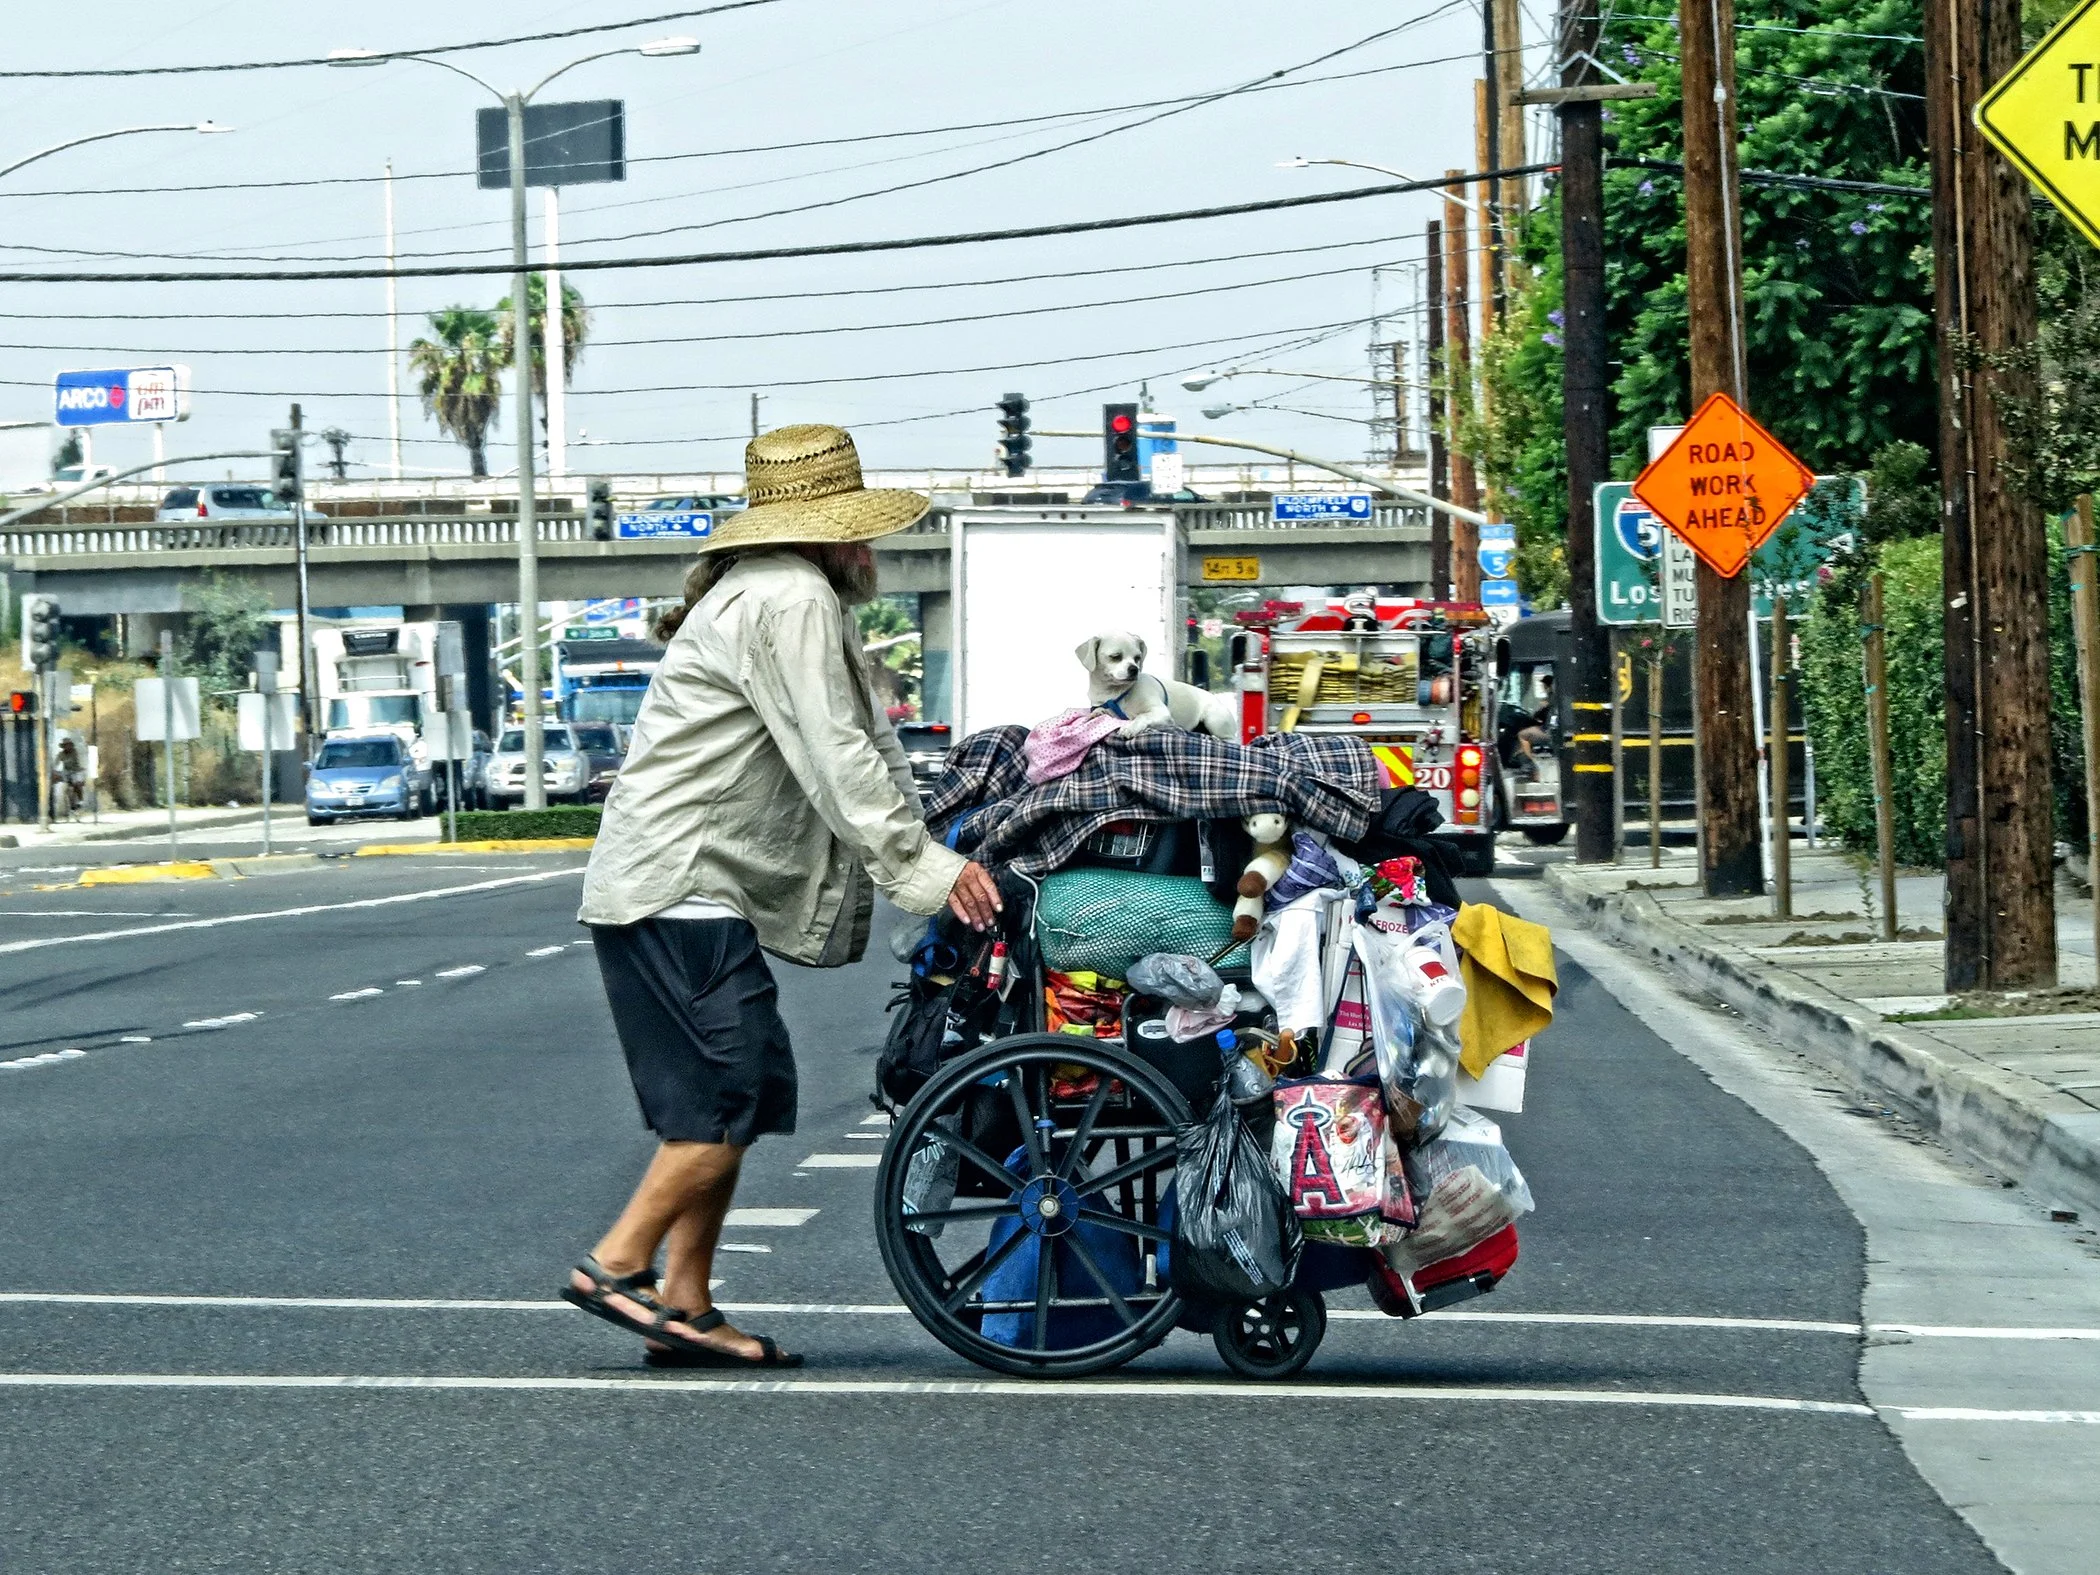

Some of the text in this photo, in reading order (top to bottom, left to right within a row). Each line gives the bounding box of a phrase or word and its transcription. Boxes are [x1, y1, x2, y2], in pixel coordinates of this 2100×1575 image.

[2067, 63, 2100, 104] T
[2063, 120, 2100, 161] M
[59, 387, 108, 410] ARCO
[1689, 441, 1754, 464] ROAD
[1690, 474, 1756, 496] WORK
[1284, 504, 1327, 513] NORTH
[1685, 506, 1766, 530] AHEAD
[1637, 517, 1659, 547] 5
[1492, 556, 1505, 572] 5
[1671, 548, 1693, 562] LA
[1672, 567, 1695, 582] MU
[1610, 580, 1661, 605] Los
[1672, 587, 1695, 602] TU
[1672, 607, 1698, 623] RIG
[1414, 767, 1452, 789] 20
[1376, 919, 1408, 934] FROZE
